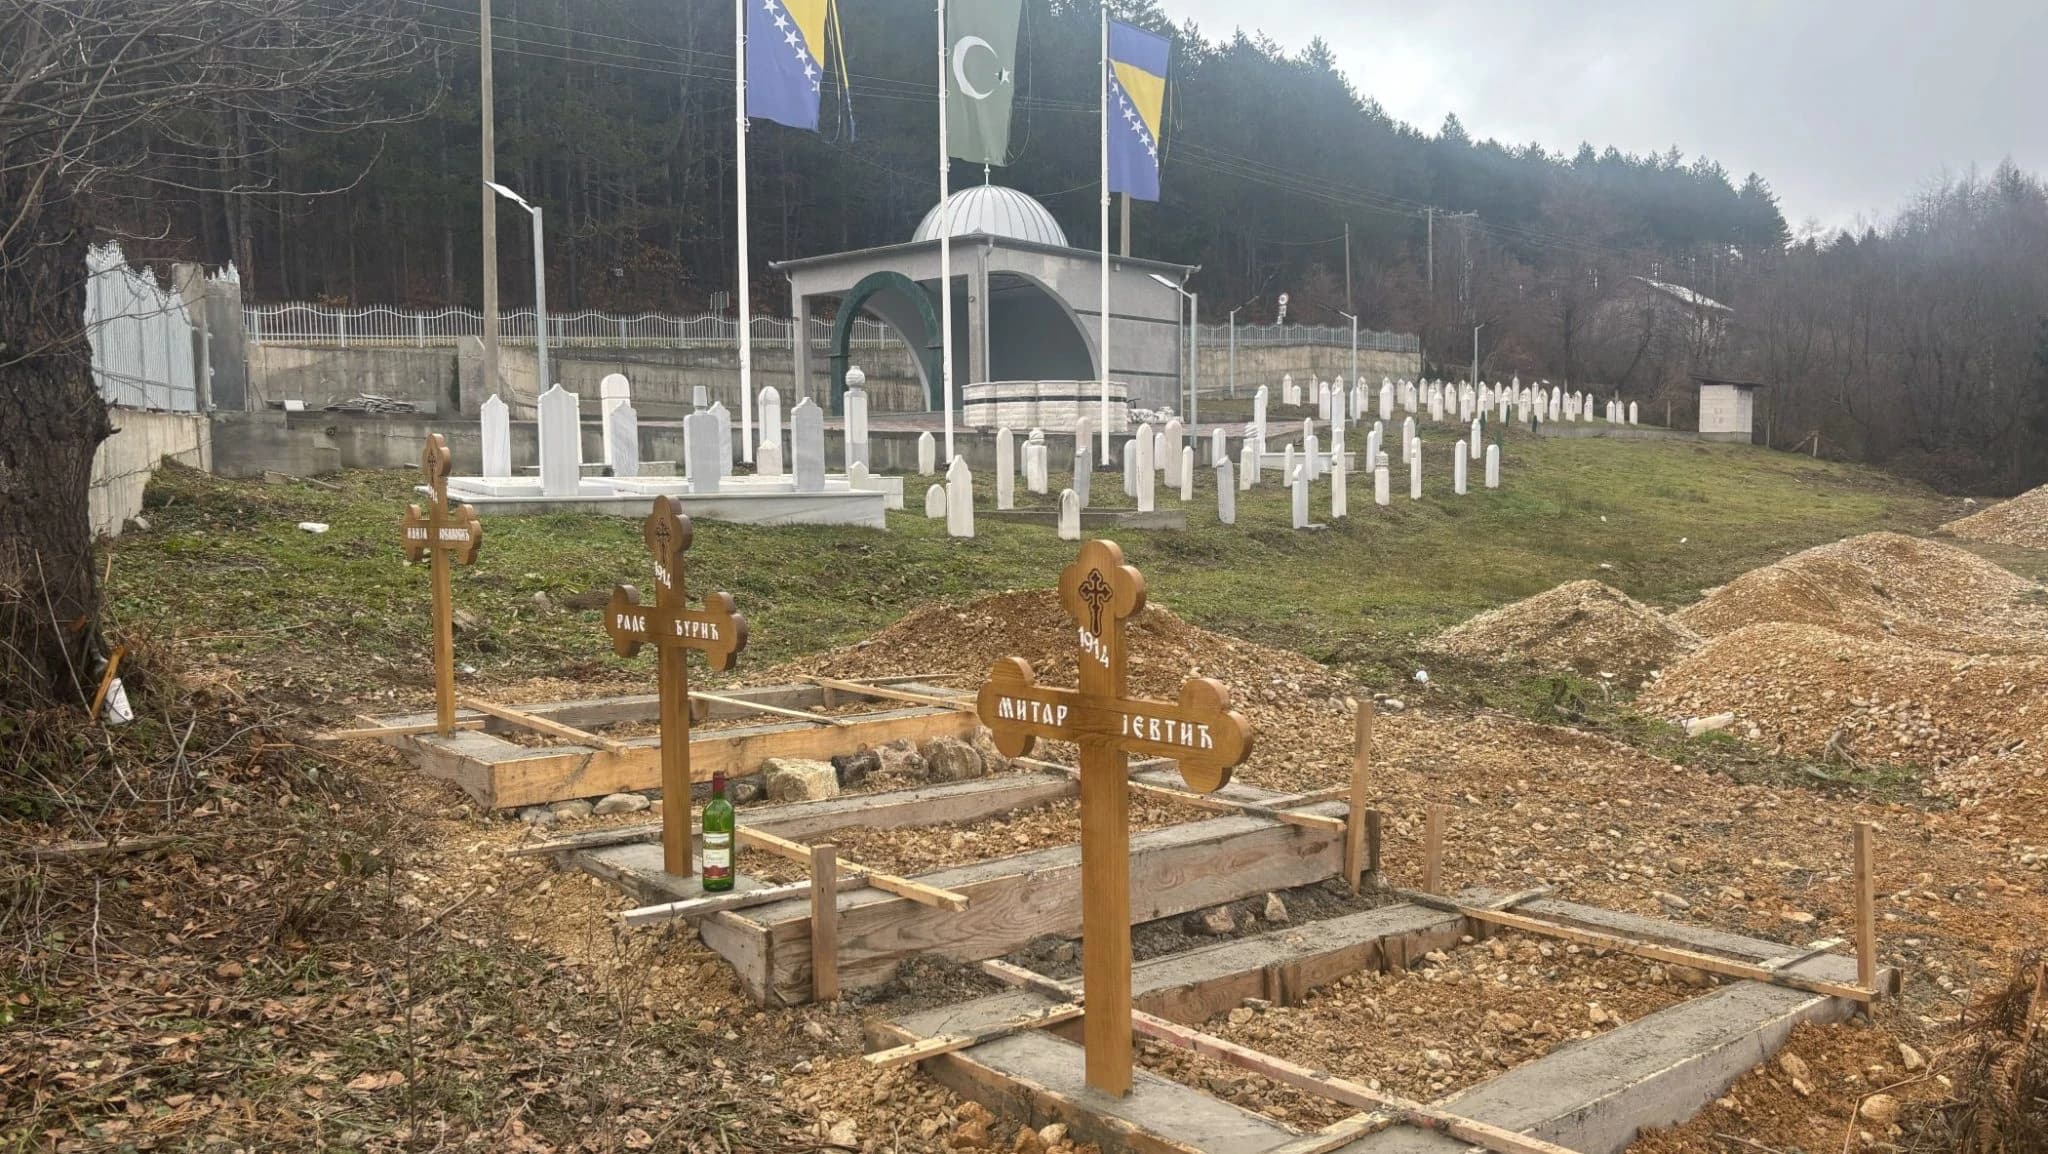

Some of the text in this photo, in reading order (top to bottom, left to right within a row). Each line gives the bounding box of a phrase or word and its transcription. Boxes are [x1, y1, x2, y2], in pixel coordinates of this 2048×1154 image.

[654, 560, 671, 590] 1914
[1077, 626, 1110, 669] 1914
[998, 696, 1214, 750] МИТАР ЈЕВТИЋ
